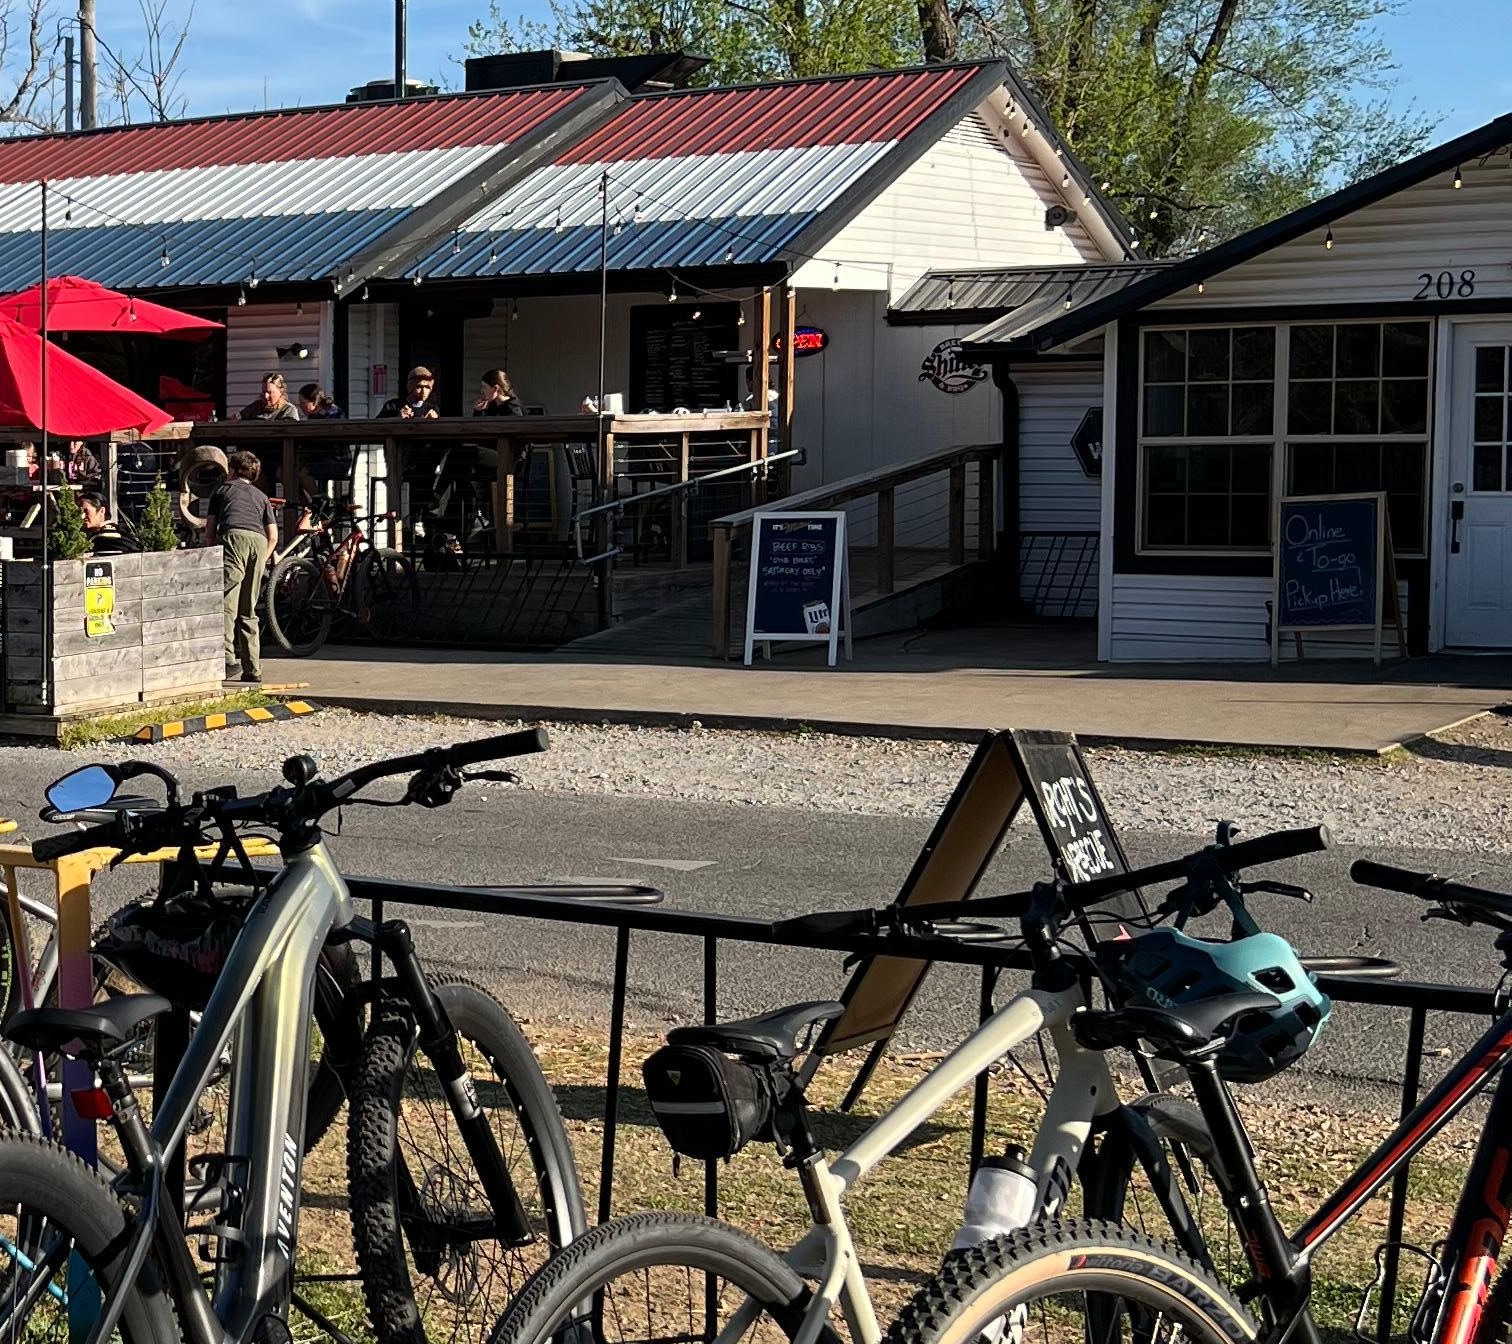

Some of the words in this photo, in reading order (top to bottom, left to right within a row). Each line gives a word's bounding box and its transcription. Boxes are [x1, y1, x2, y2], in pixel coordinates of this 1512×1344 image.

[1413, 269, 1475, 301] 208
[1285, 513, 1346, 545] Online
[94, 567, 104, 577] NO
[1304, 542, 1357, 571] To-go
[1285, 579, 1328, 610] Pickup
[1089, 1254, 1144, 1273] vittoria
[1149, 1264, 1245, 1340] BARZO
